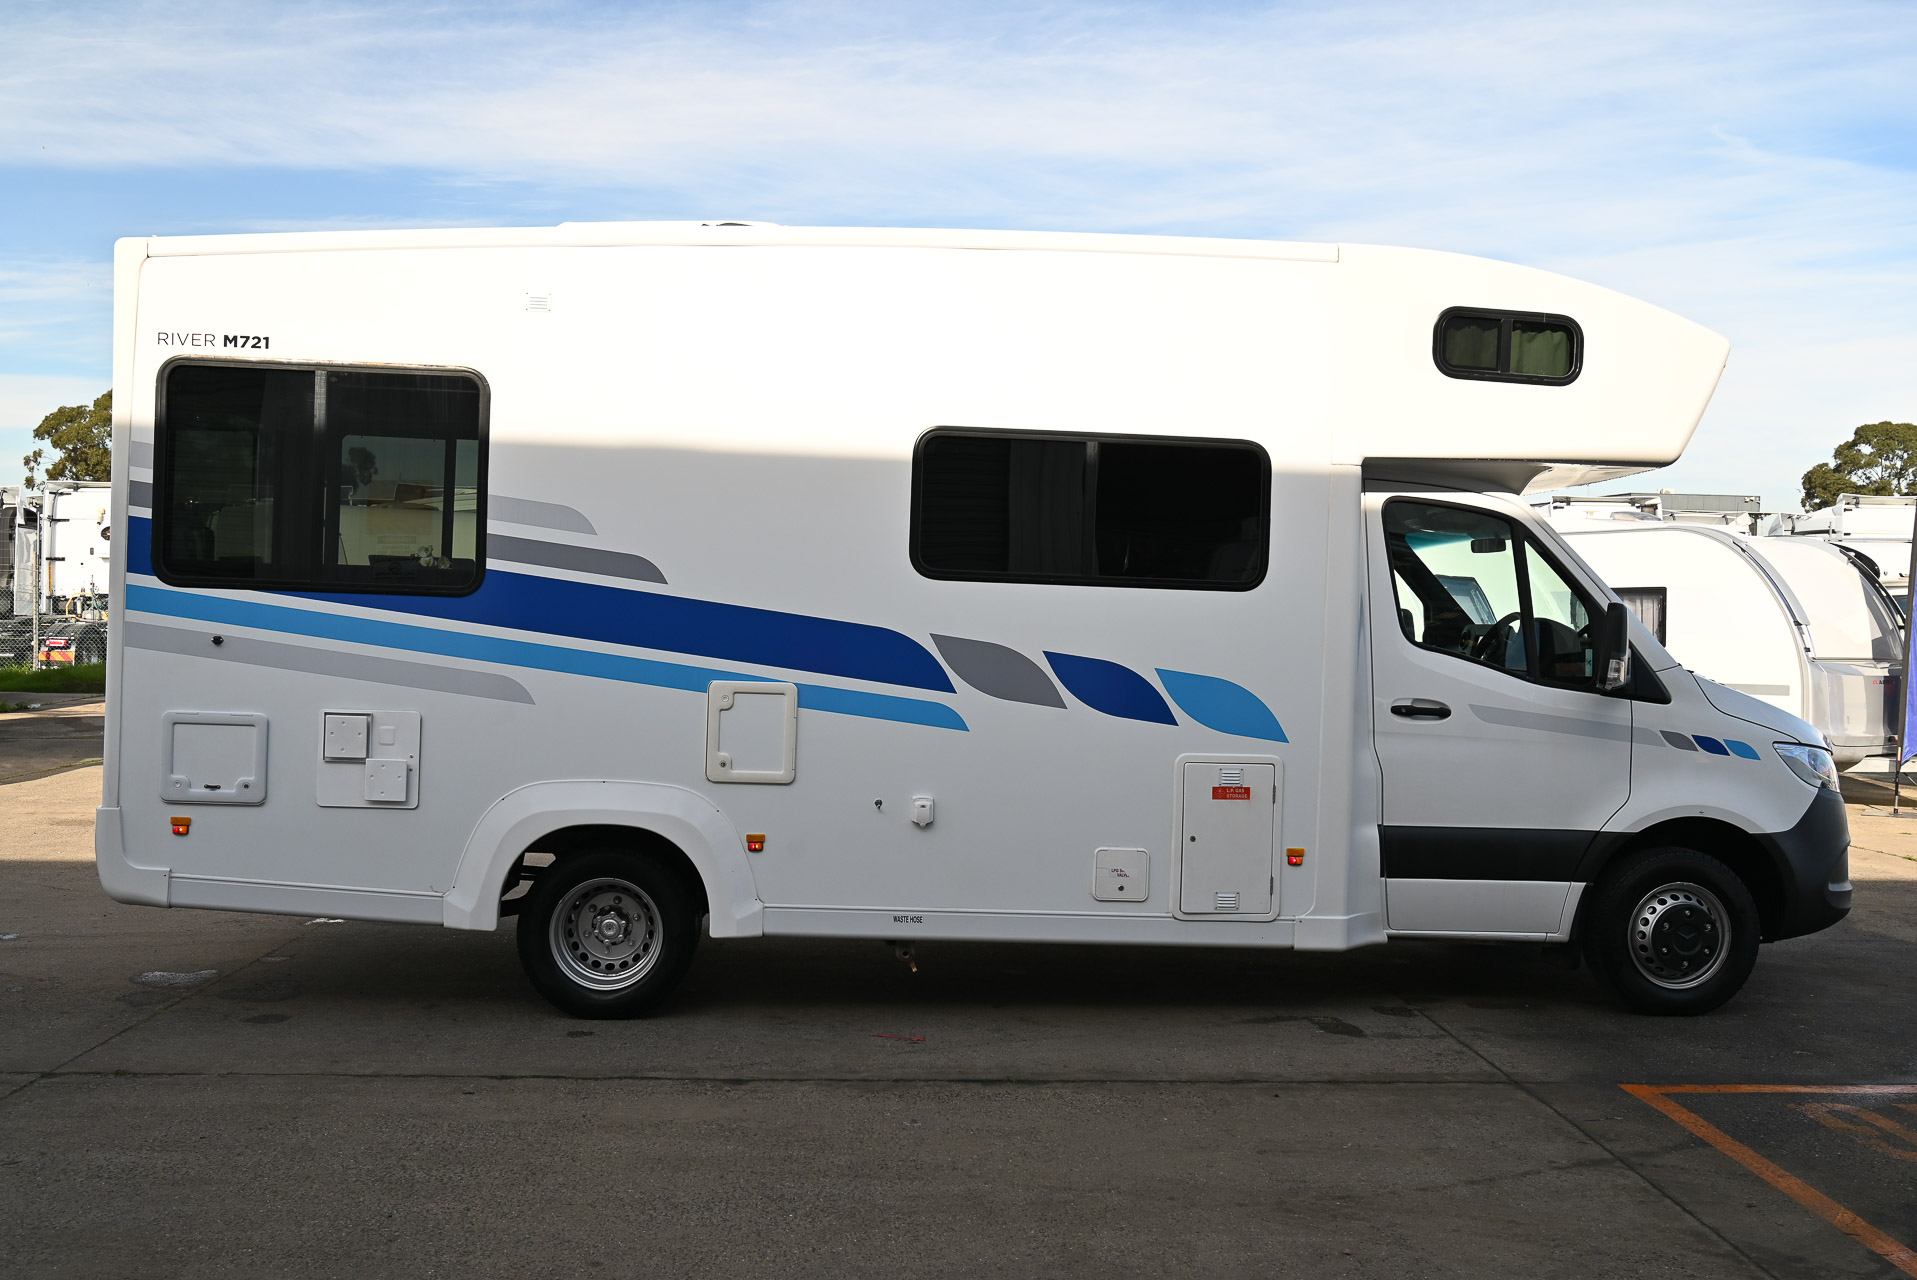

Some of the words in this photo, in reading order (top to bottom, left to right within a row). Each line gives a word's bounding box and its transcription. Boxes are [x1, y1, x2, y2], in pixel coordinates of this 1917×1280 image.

[157, 332, 216, 347] RIVER
[223, 334, 270, 350] M721
[893, 915, 909, 923] WASTE
[910, 915, 923, 924] HOSE
